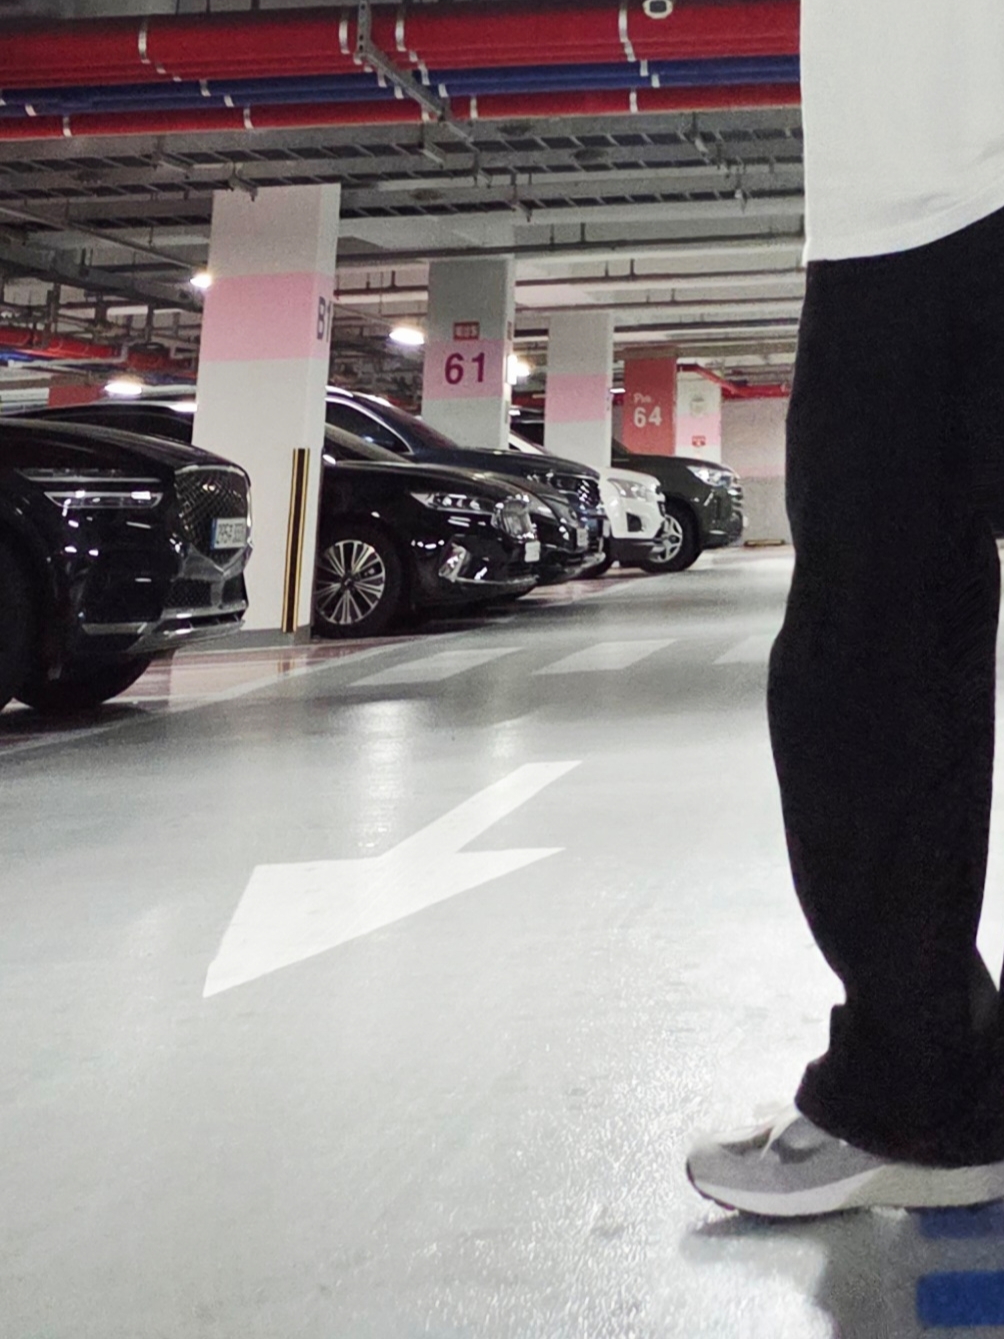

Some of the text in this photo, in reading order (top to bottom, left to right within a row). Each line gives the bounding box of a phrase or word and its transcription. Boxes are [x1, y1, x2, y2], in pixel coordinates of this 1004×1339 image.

[316, 295, 331, 342] B1
[444, 352, 485, 385] 61
[633, 406, 662, 428] 64
